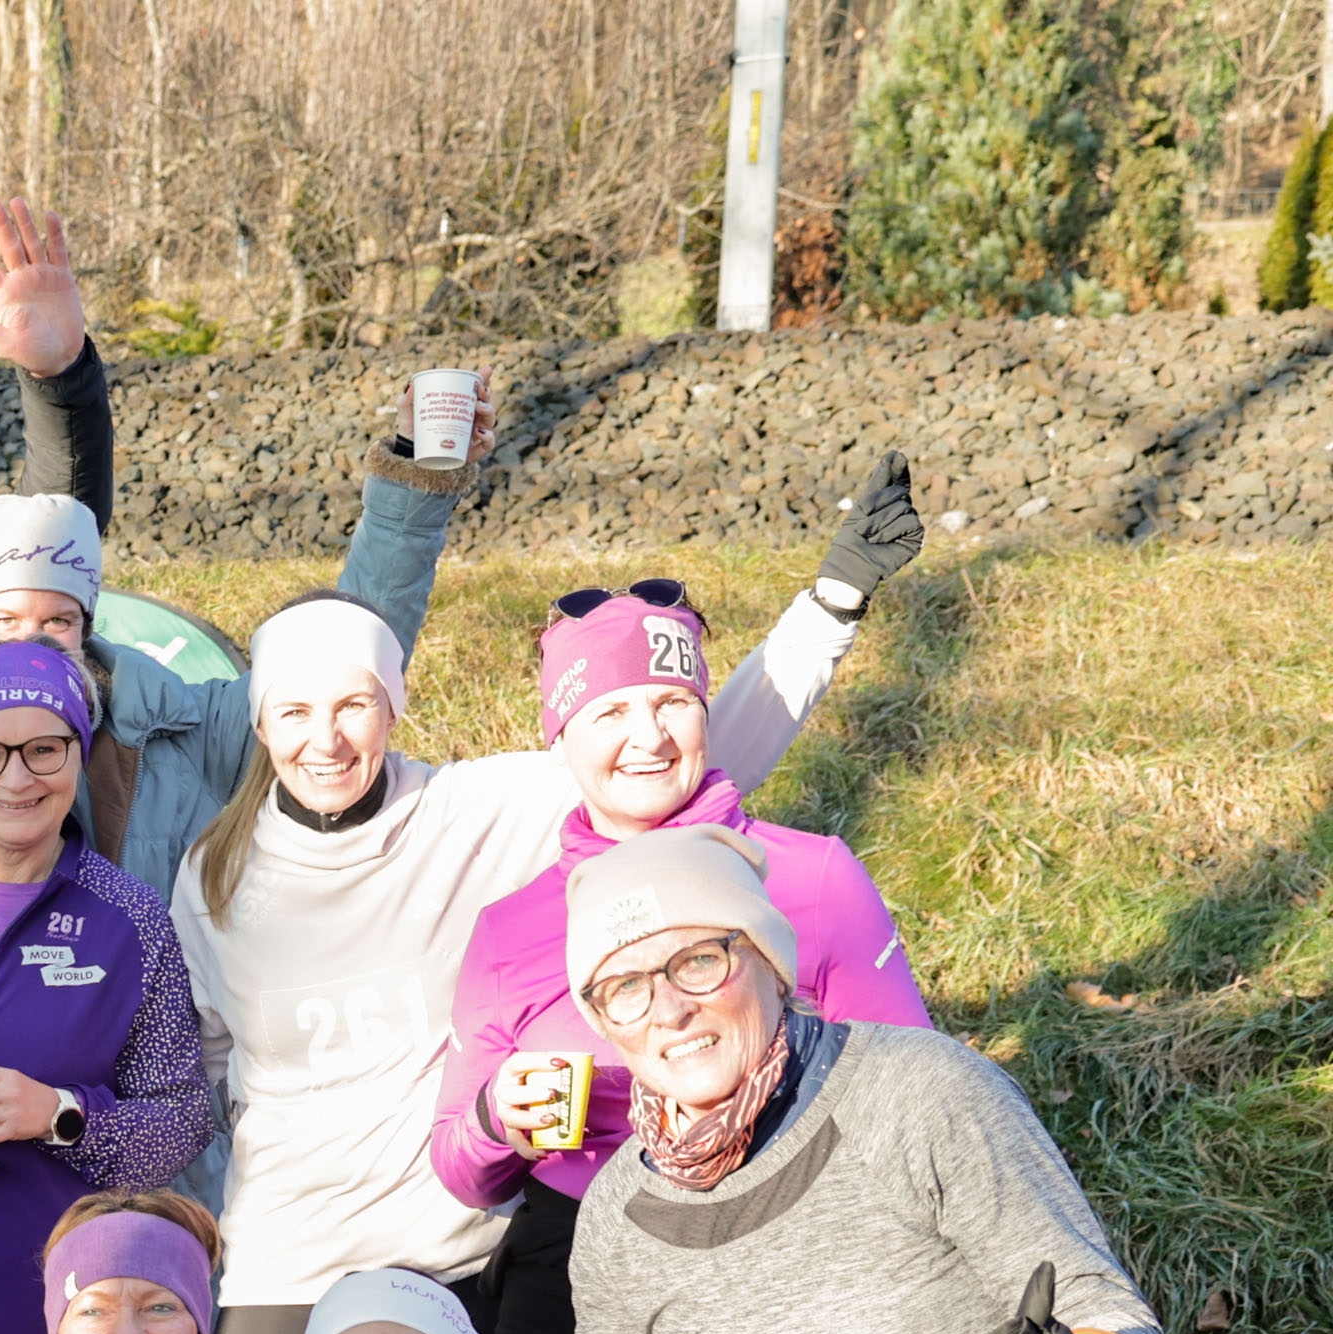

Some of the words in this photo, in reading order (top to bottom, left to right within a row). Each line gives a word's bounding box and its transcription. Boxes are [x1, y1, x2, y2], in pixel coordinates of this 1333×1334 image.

[47, 911, 84, 936] 261
[29, 950, 65, 960] MOVE
[53, 970, 94, 981] WORLD
[296, 971, 432, 1072] 261
